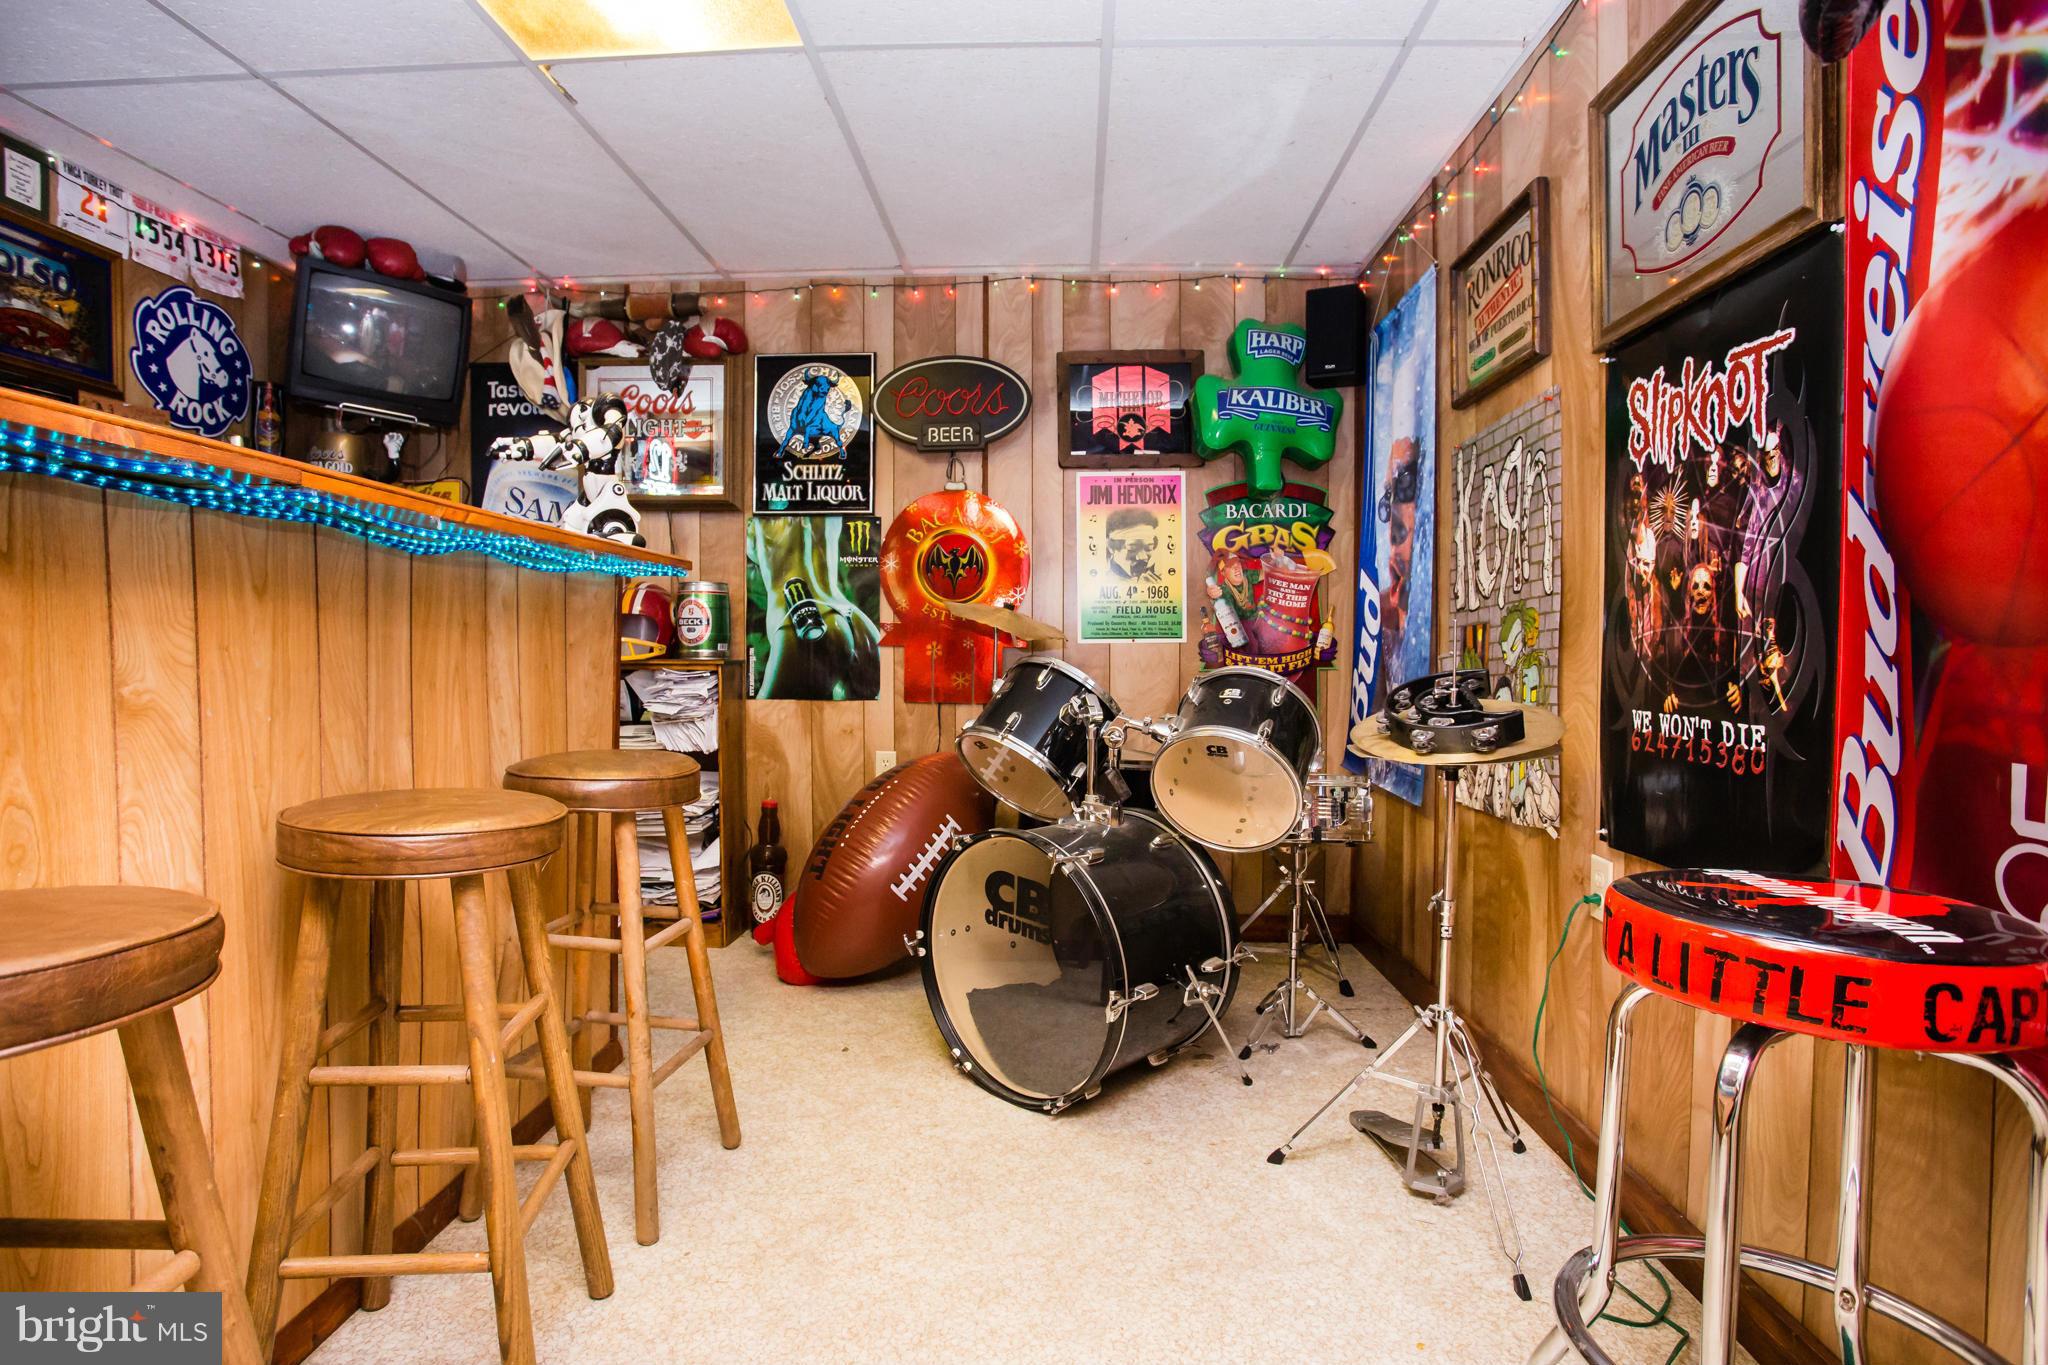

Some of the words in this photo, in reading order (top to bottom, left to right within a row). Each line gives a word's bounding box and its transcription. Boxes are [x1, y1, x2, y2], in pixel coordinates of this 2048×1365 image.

[1634, 46, 1761, 215] Masters
[1709, 140, 1729, 154] BEER
[135, 212, 186, 258] 1554
[193, 237, 240, 278] 1315
[1467, 230, 1532, 316] RONRICO
[145, 301, 238, 357] ROLLING
[1250, 332, 1302, 354] HARP
[169, 392, 231, 425] ROCK
[621, 384, 697, 415] Coors
[890, 376, 1009, 418] Coors
[1231, 389, 1325, 416] KALIBER
[625, 418, 687, 438] LIGHT
[928, 426, 974, 443] BEER
[325, 461, 353, 474] GOLD
[782, 461, 844, 481] SCHLITZ
[762, 482, 803, 501] MALT
[807, 481, 867, 505] LIQUOR
[1087, 485, 1113, 505] JIMI
[1117, 484, 1177, 505] HENDRIX
[1225, 503, 1309, 519] BACARDI
[1212, 521, 1319, 552] GRAS
[1099, 586, 1121, 599] AUG.
[1147, 585, 1169, 599] 1968
[1268, 577, 1288, 588] WEE
[1290, 583, 1311, 591] MAN
[1268, 589, 1285, 598] TRY
[1116, 606, 1142, 614] FIELD
[1146, 606, 1178, 614] HOUSE
[1278, 599, 1307, 608] HOME
[1225, 649, 1252, 663] LIFT
[1254, 656, 1279, 665] 'EM
[1281, 648, 1313, 663] HIGH
[1351, 568, 1381, 726] Bud
[1288, 656, 1312, 671] FLY
[1631, 709, 1653, 733] WE
[1659, 712, 1711, 741] WON'T
[1721, 720, 1766, 752] DIE
[1206, 745, 1228, 754] CB
[985, 870, 1052, 926] CB
[985, 908, 1051, 945] drums
[1618, 920, 1636, 975] A
[1651, 933, 1873, 1035] LITTLE
